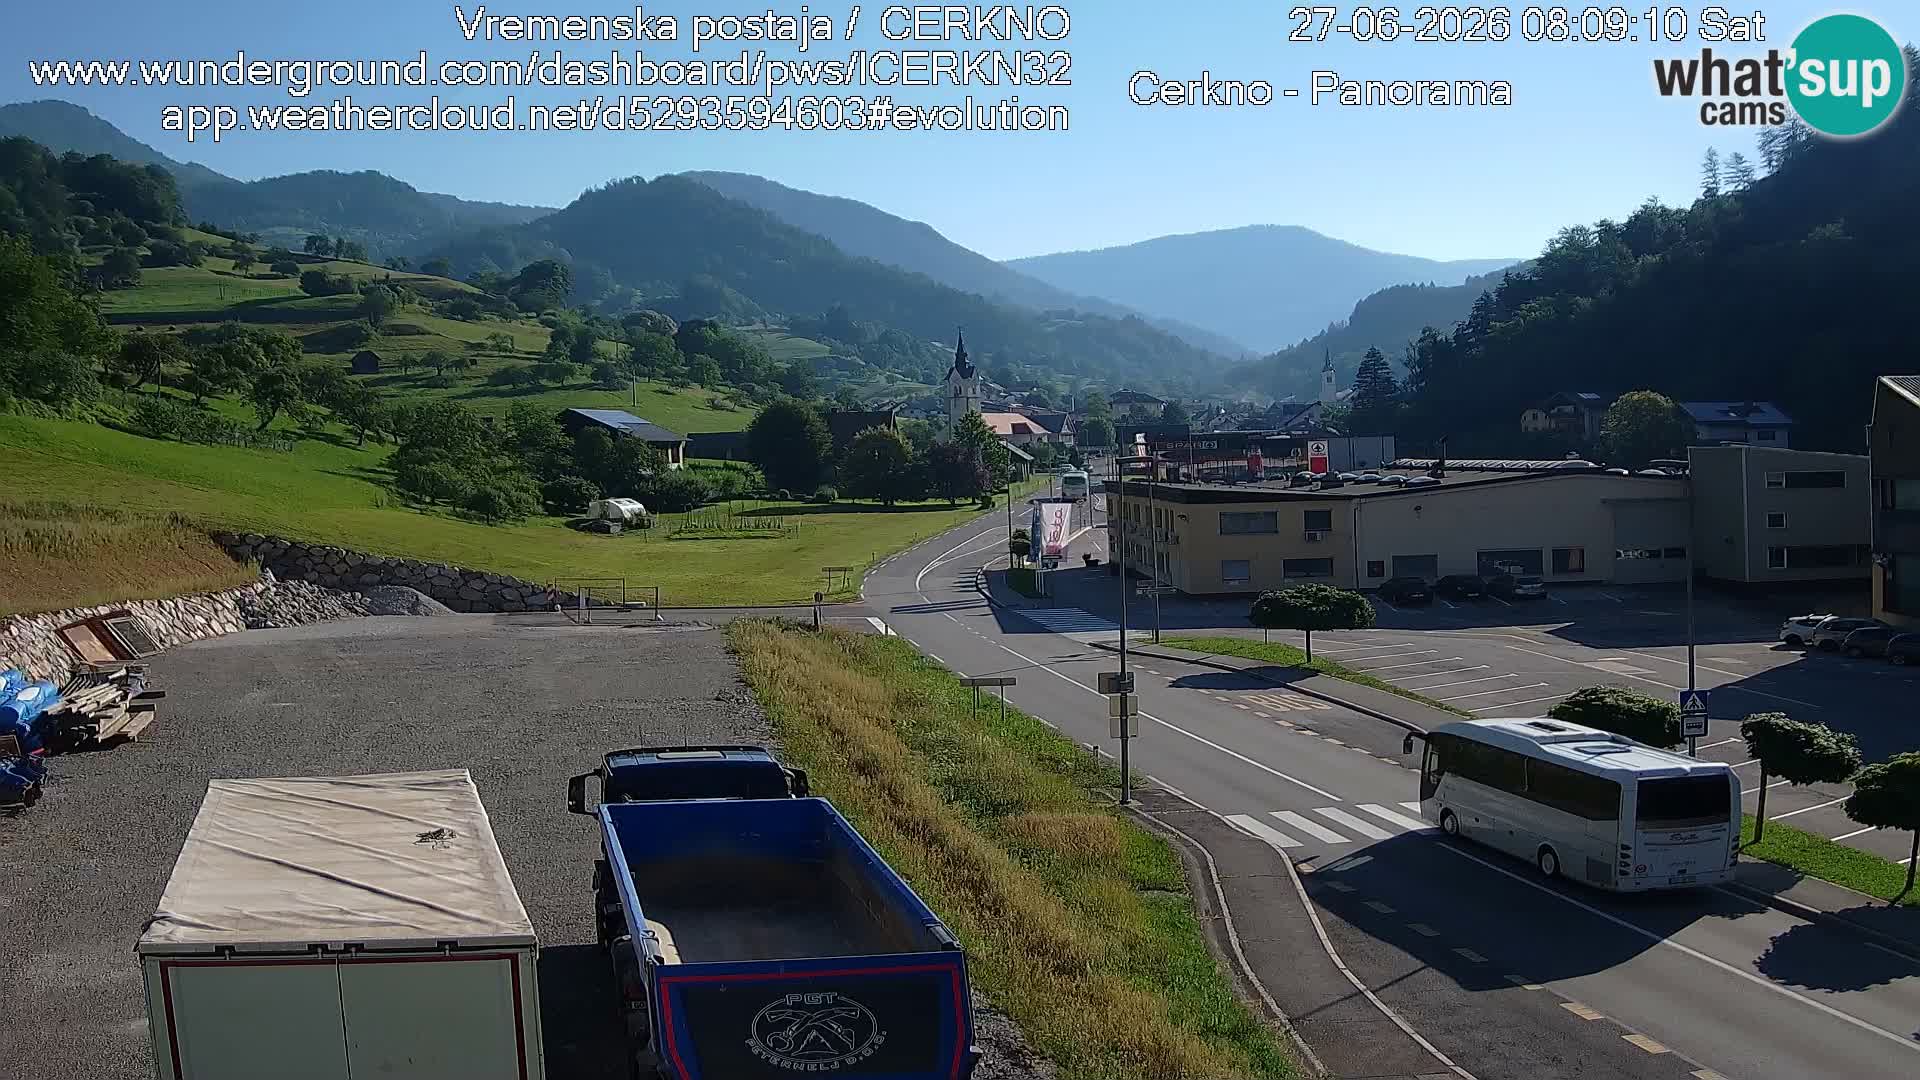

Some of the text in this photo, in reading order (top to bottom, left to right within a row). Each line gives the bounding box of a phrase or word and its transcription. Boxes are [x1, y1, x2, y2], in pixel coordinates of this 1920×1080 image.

[1240, 694, 1333, 712] BUS
[785, 992, 838, 1005] PGT
[744, 1038, 840, 1071] PETERNELJ
